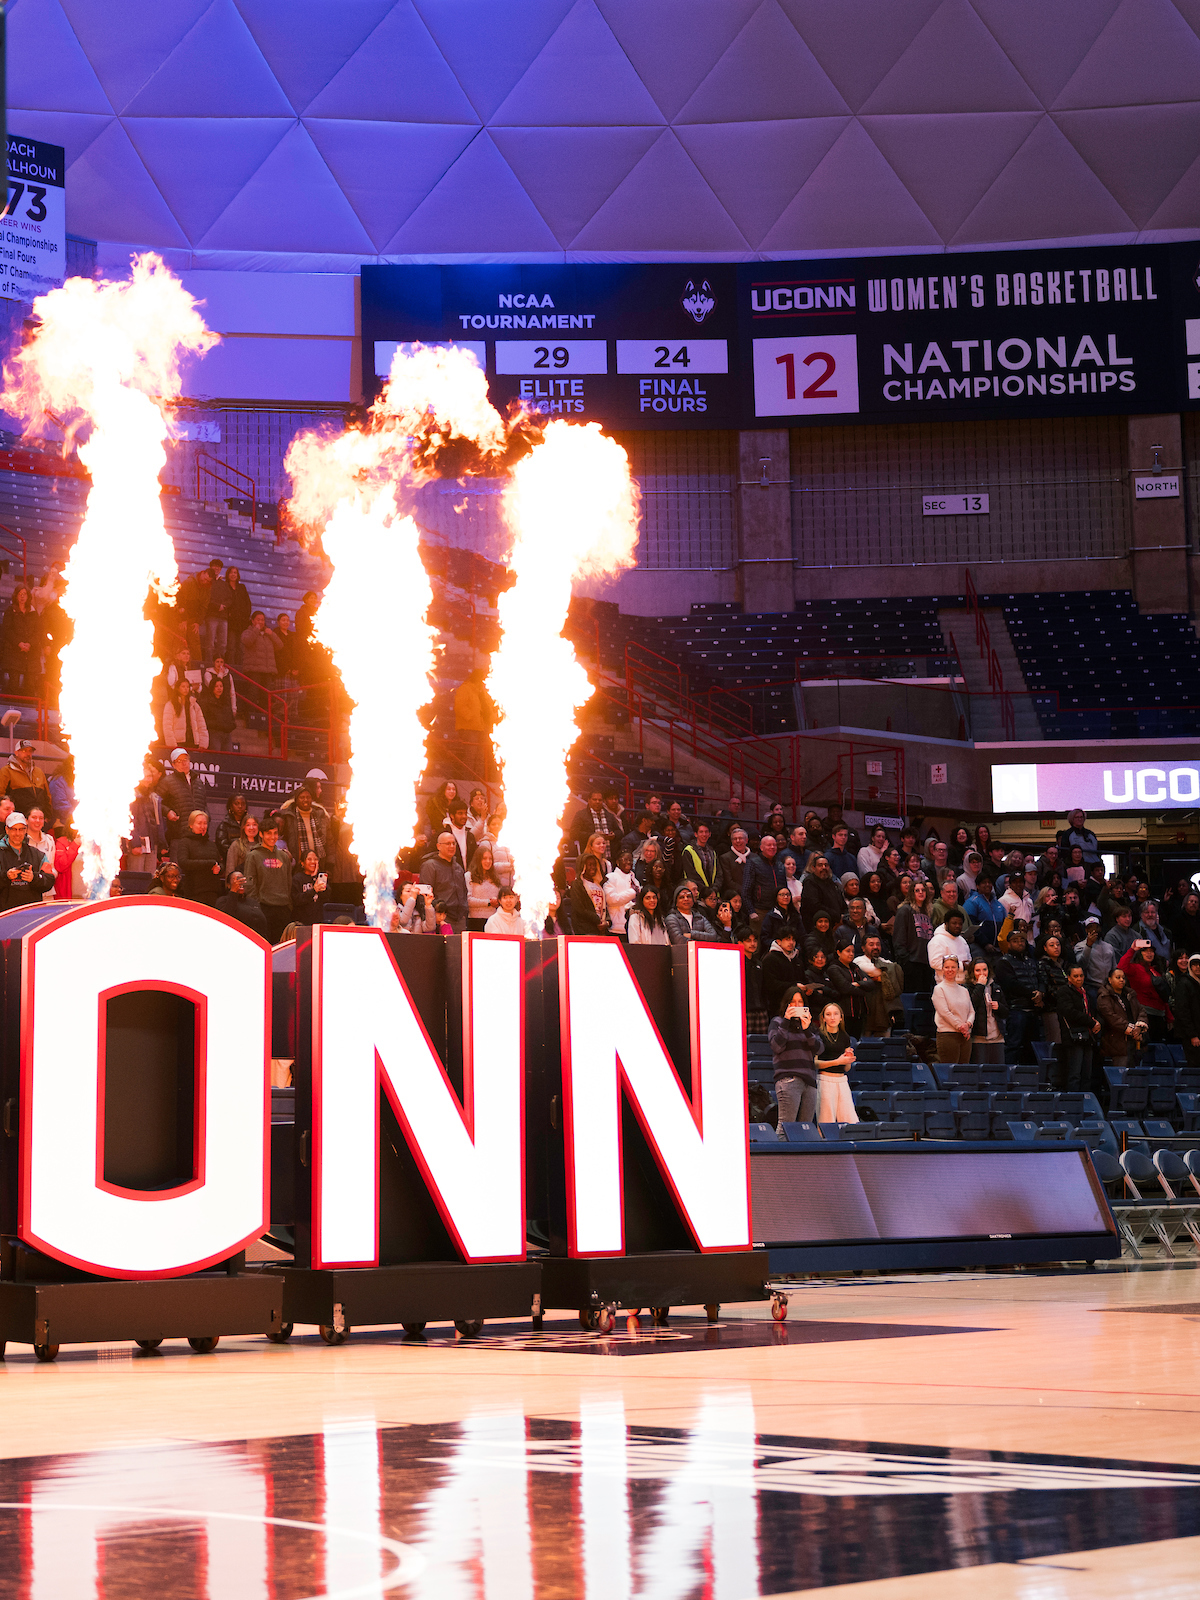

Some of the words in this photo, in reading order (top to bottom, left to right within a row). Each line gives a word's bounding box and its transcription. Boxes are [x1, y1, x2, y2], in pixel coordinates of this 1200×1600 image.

[5, 158, 57, 181] ALHOUN
[7, 180, 47, 222] 73
[20, 222, 42, 233] WINS
[6, 231, 58, 253] Championships
[17, 250, 37, 264] Fours
[2, 281, 10, 292] of
[751, 286, 856, 312] UCONN
[868, 274, 985, 312] WOMEN'S
[997, 266, 1158, 307] BASKETBALL
[498, 293, 555, 309] NCAA
[459, 314, 596, 329] TOURNAMENT
[533, 346, 570, 369] 29
[653, 346, 691, 368] 24
[882, 333, 1134, 376] NATIONAL
[775, 351, 838, 400] 12
[519, 379, 585, 397] ELITE
[639, 379, 707, 395] FINAL
[882, 370, 1137, 402] CHAMPIONSHIPS
[640, 397, 708, 413] FOURS
[1136, 481, 1178, 493] NORTH
[924, 500, 947, 511] SEC
[962, 497, 982, 512] 13
[865, 816, 904, 828] CONCESSIONS
